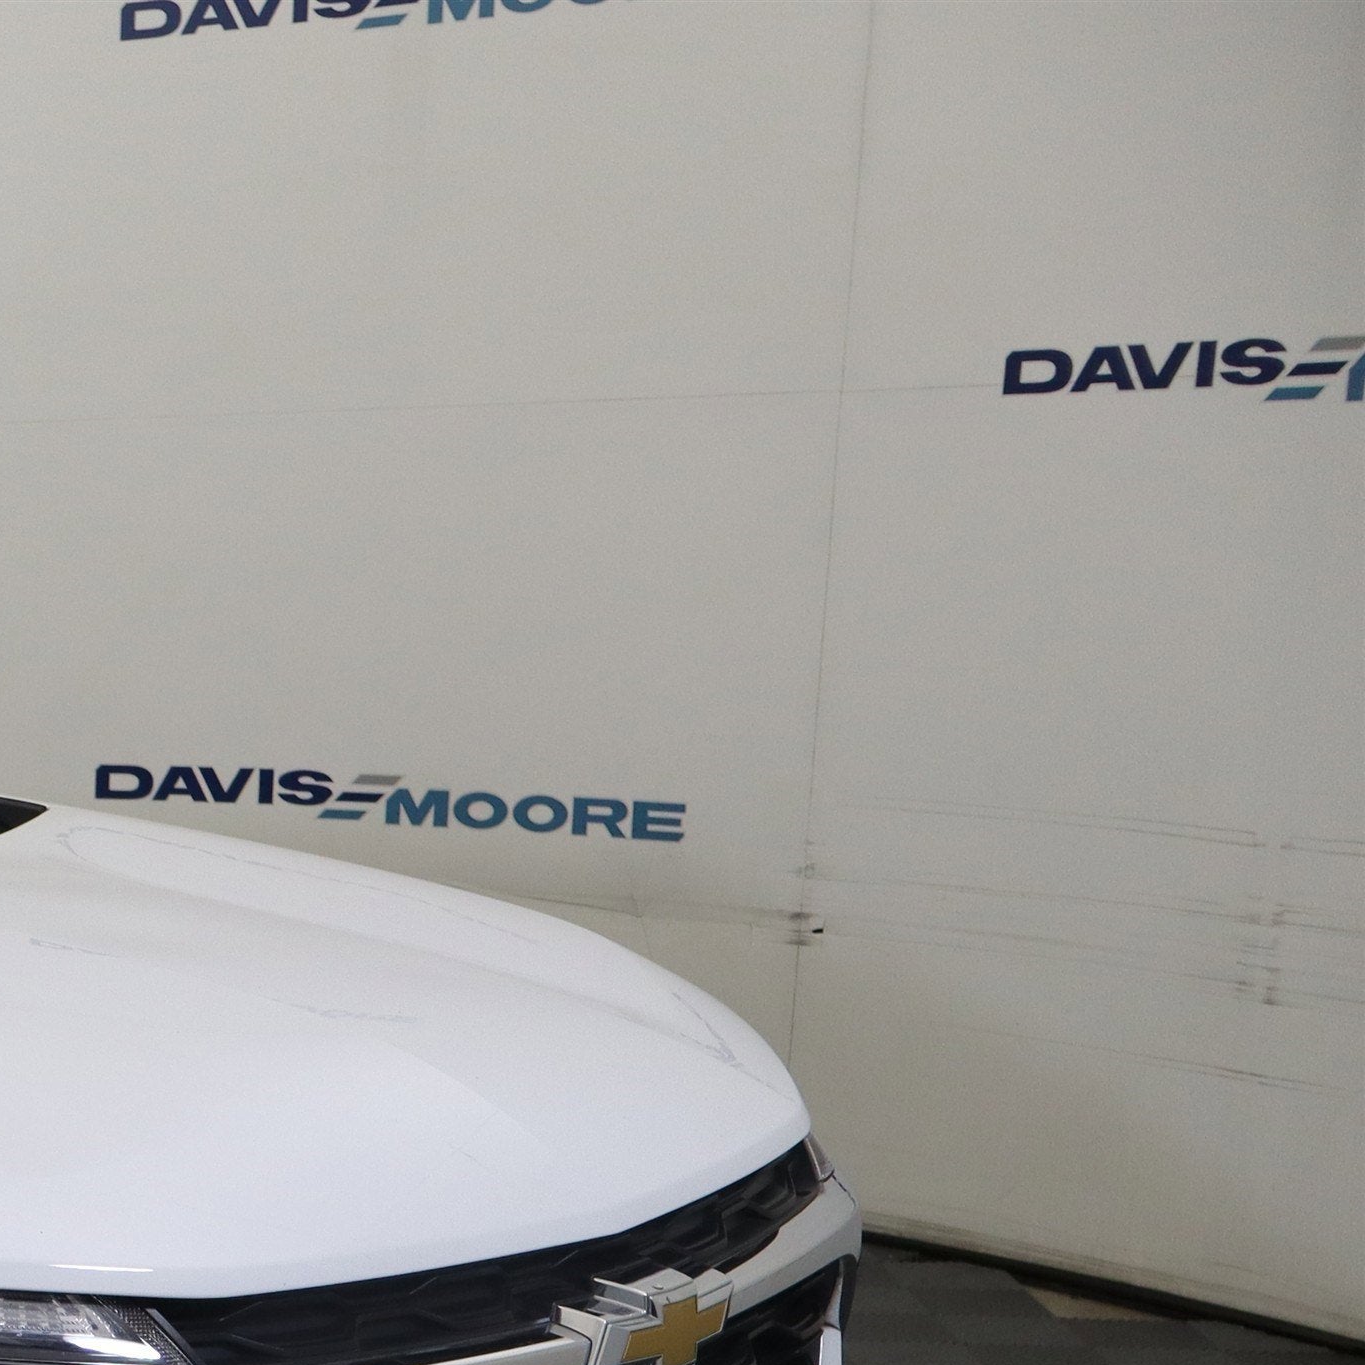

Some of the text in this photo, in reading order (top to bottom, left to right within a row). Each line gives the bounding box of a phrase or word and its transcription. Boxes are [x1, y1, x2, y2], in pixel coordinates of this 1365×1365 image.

[1003, 338, 1287, 395] DAVIS
[94, 764, 687, 842] DAVIS MOORE
